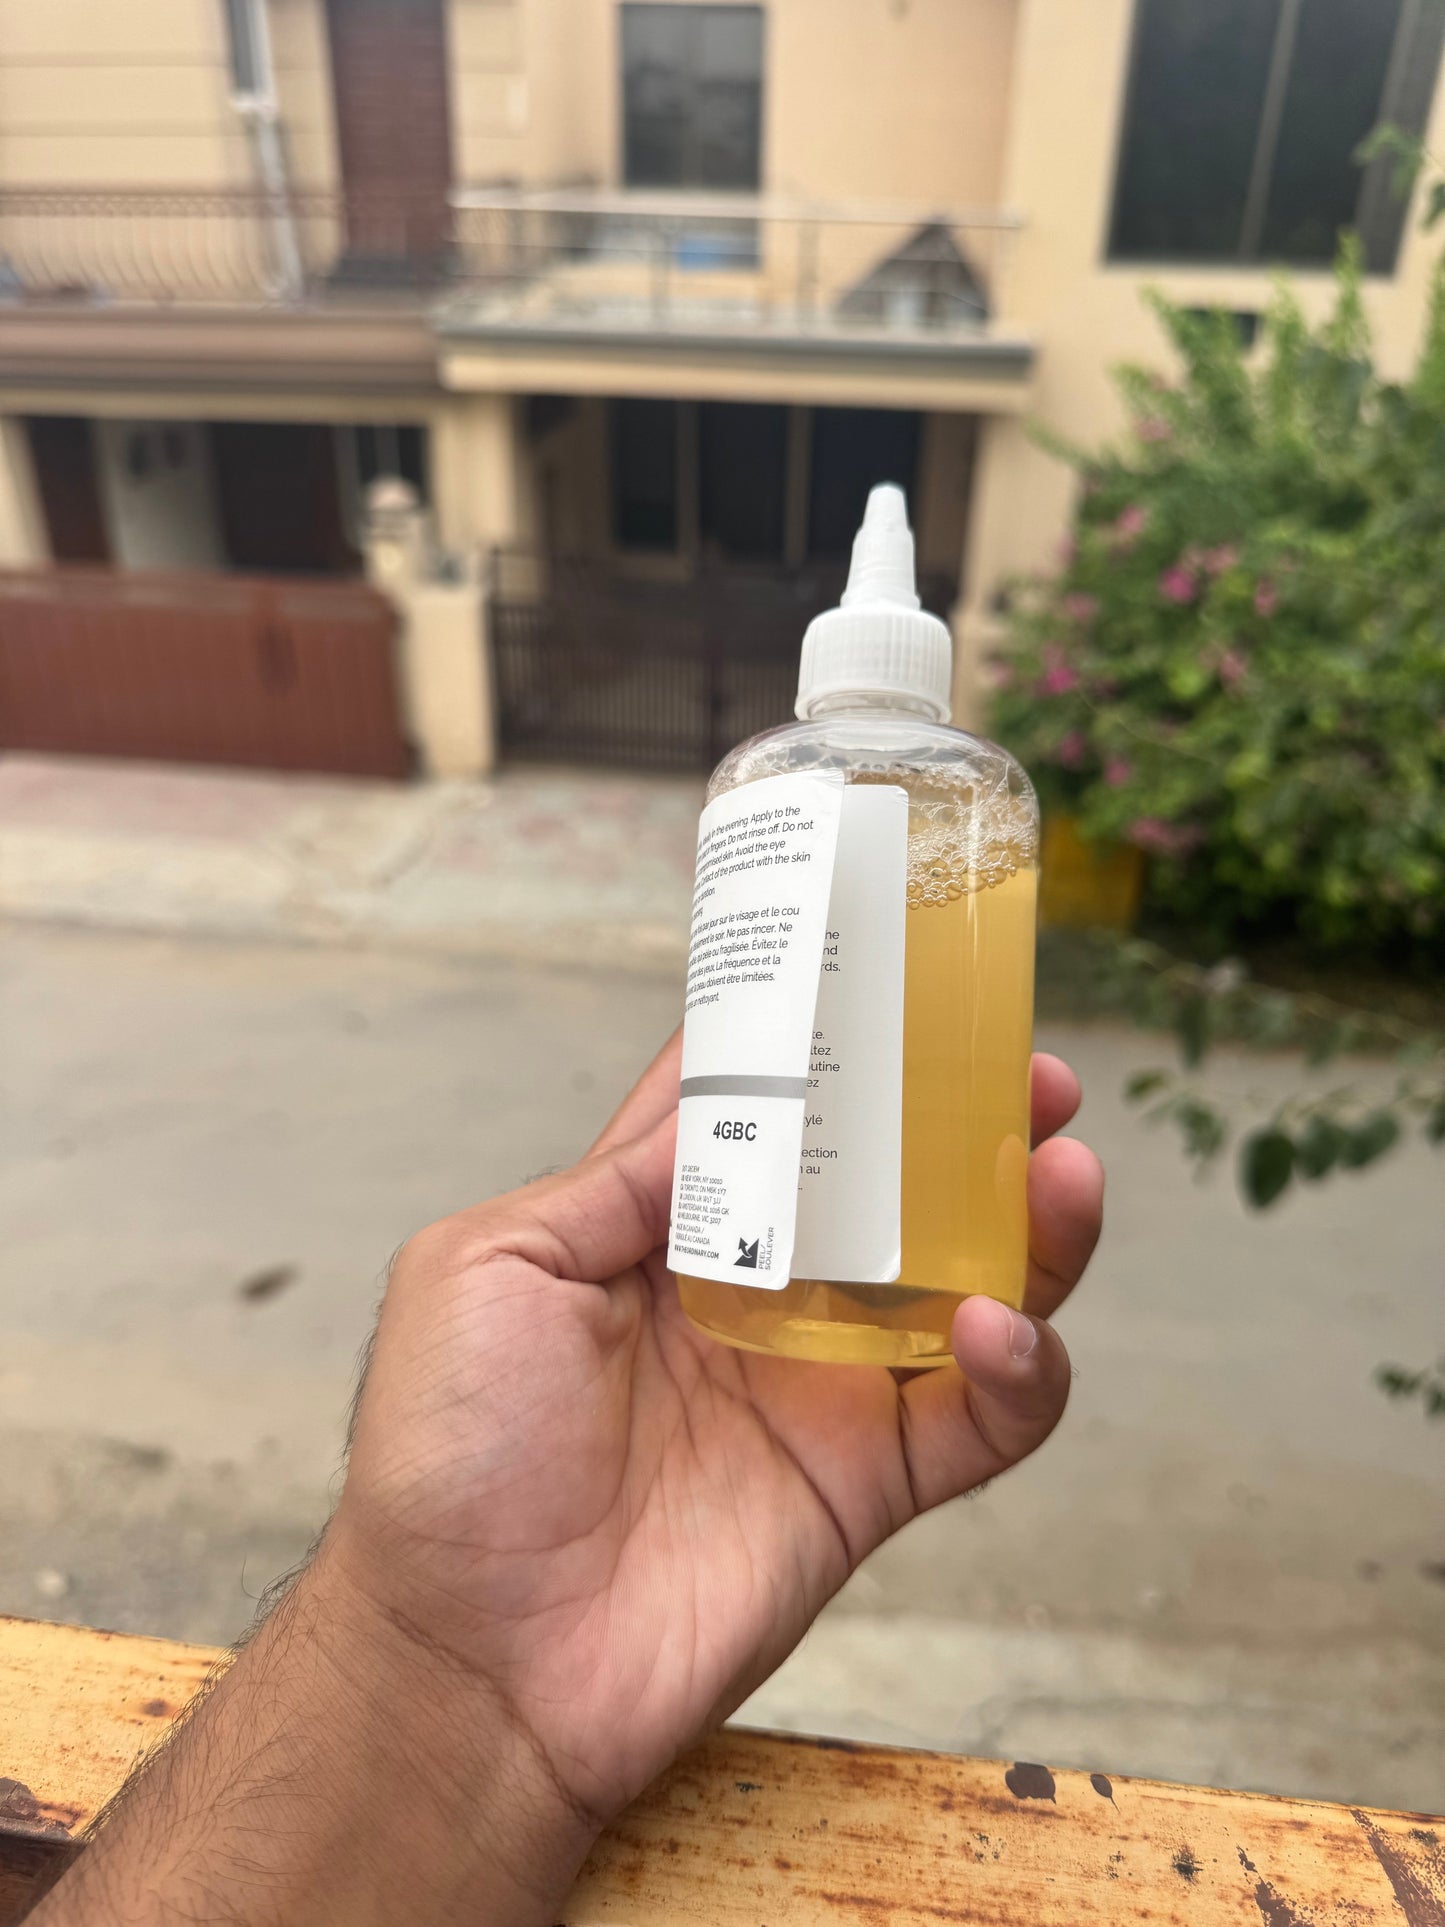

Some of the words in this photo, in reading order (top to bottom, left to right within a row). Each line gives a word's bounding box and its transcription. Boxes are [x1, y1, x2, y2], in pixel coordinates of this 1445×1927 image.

[717, 825, 725, 836] the
[750, 809, 773, 823] Apply
[774, 808, 783, 819] to
[785, 806, 801, 816] the
[728, 834, 736, 845] Do
[736, 831, 747, 842] not
[748, 828, 766, 839] rinse
[767, 823, 780, 835] off.
[782, 821, 795, 833] Do
[797, 819, 814, 831] not
[735, 843, 754, 857] Avoid
[755, 841, 768, 852] the
[769, 840, 786, 852] eye
[714, 868, 721, 880] of
[720, 866, 728, 877] the
[728, 858, 755, 876] product
[756, 856, 773, 867] with
[775, 853, 789, 865] the
[791, 851, 811, 863] skin
[708, 918, 720, 931] jour
[719, 915, 729, 926] sur
[728, 912, 735, 923] le
[735, 909, 759, 922] visage
[760, 907, 769, 918] et
[771, 906, 780, 917] le
[781, 907, 800, 916] cou
[726, 928, 736, 939] Ne
[736, 926, 750, 938] pas
[751, 924, 776, 935] rincer.
[778, 922, 793, 932] Ne
[751, 937, 778, 950] Évitez
[779, 938, 788, 949] le
[715, 961, 723, 971] La
[723, 957, 760, 971] fréquence
[761, 955, 771, 965] et
[772, 954, 781, 965] la
[706, 976, 726, 988] doivent
[726, 973, 741, 984] être
[741, 971, 775, 982] limitées.
[713, 1120, 757, 1141] 4GBC
[801, 1147, 838, 1159] ection
[805, 1165, 821, 1174] au
[709, 1177, 723, 1185] 10010
[717, 1187, 727, 1196] 1Y7
[712, 1196, 722, 1205] 3JJ
[720, 1207, 730, 1215] GK
[701, 1215, 710, 1223] VIC
[709, 1217, 722, 1225] 3207
[692, 1235, 711, 1245] CANADA
[764, 1226, 775, 1270] SOULEVER
